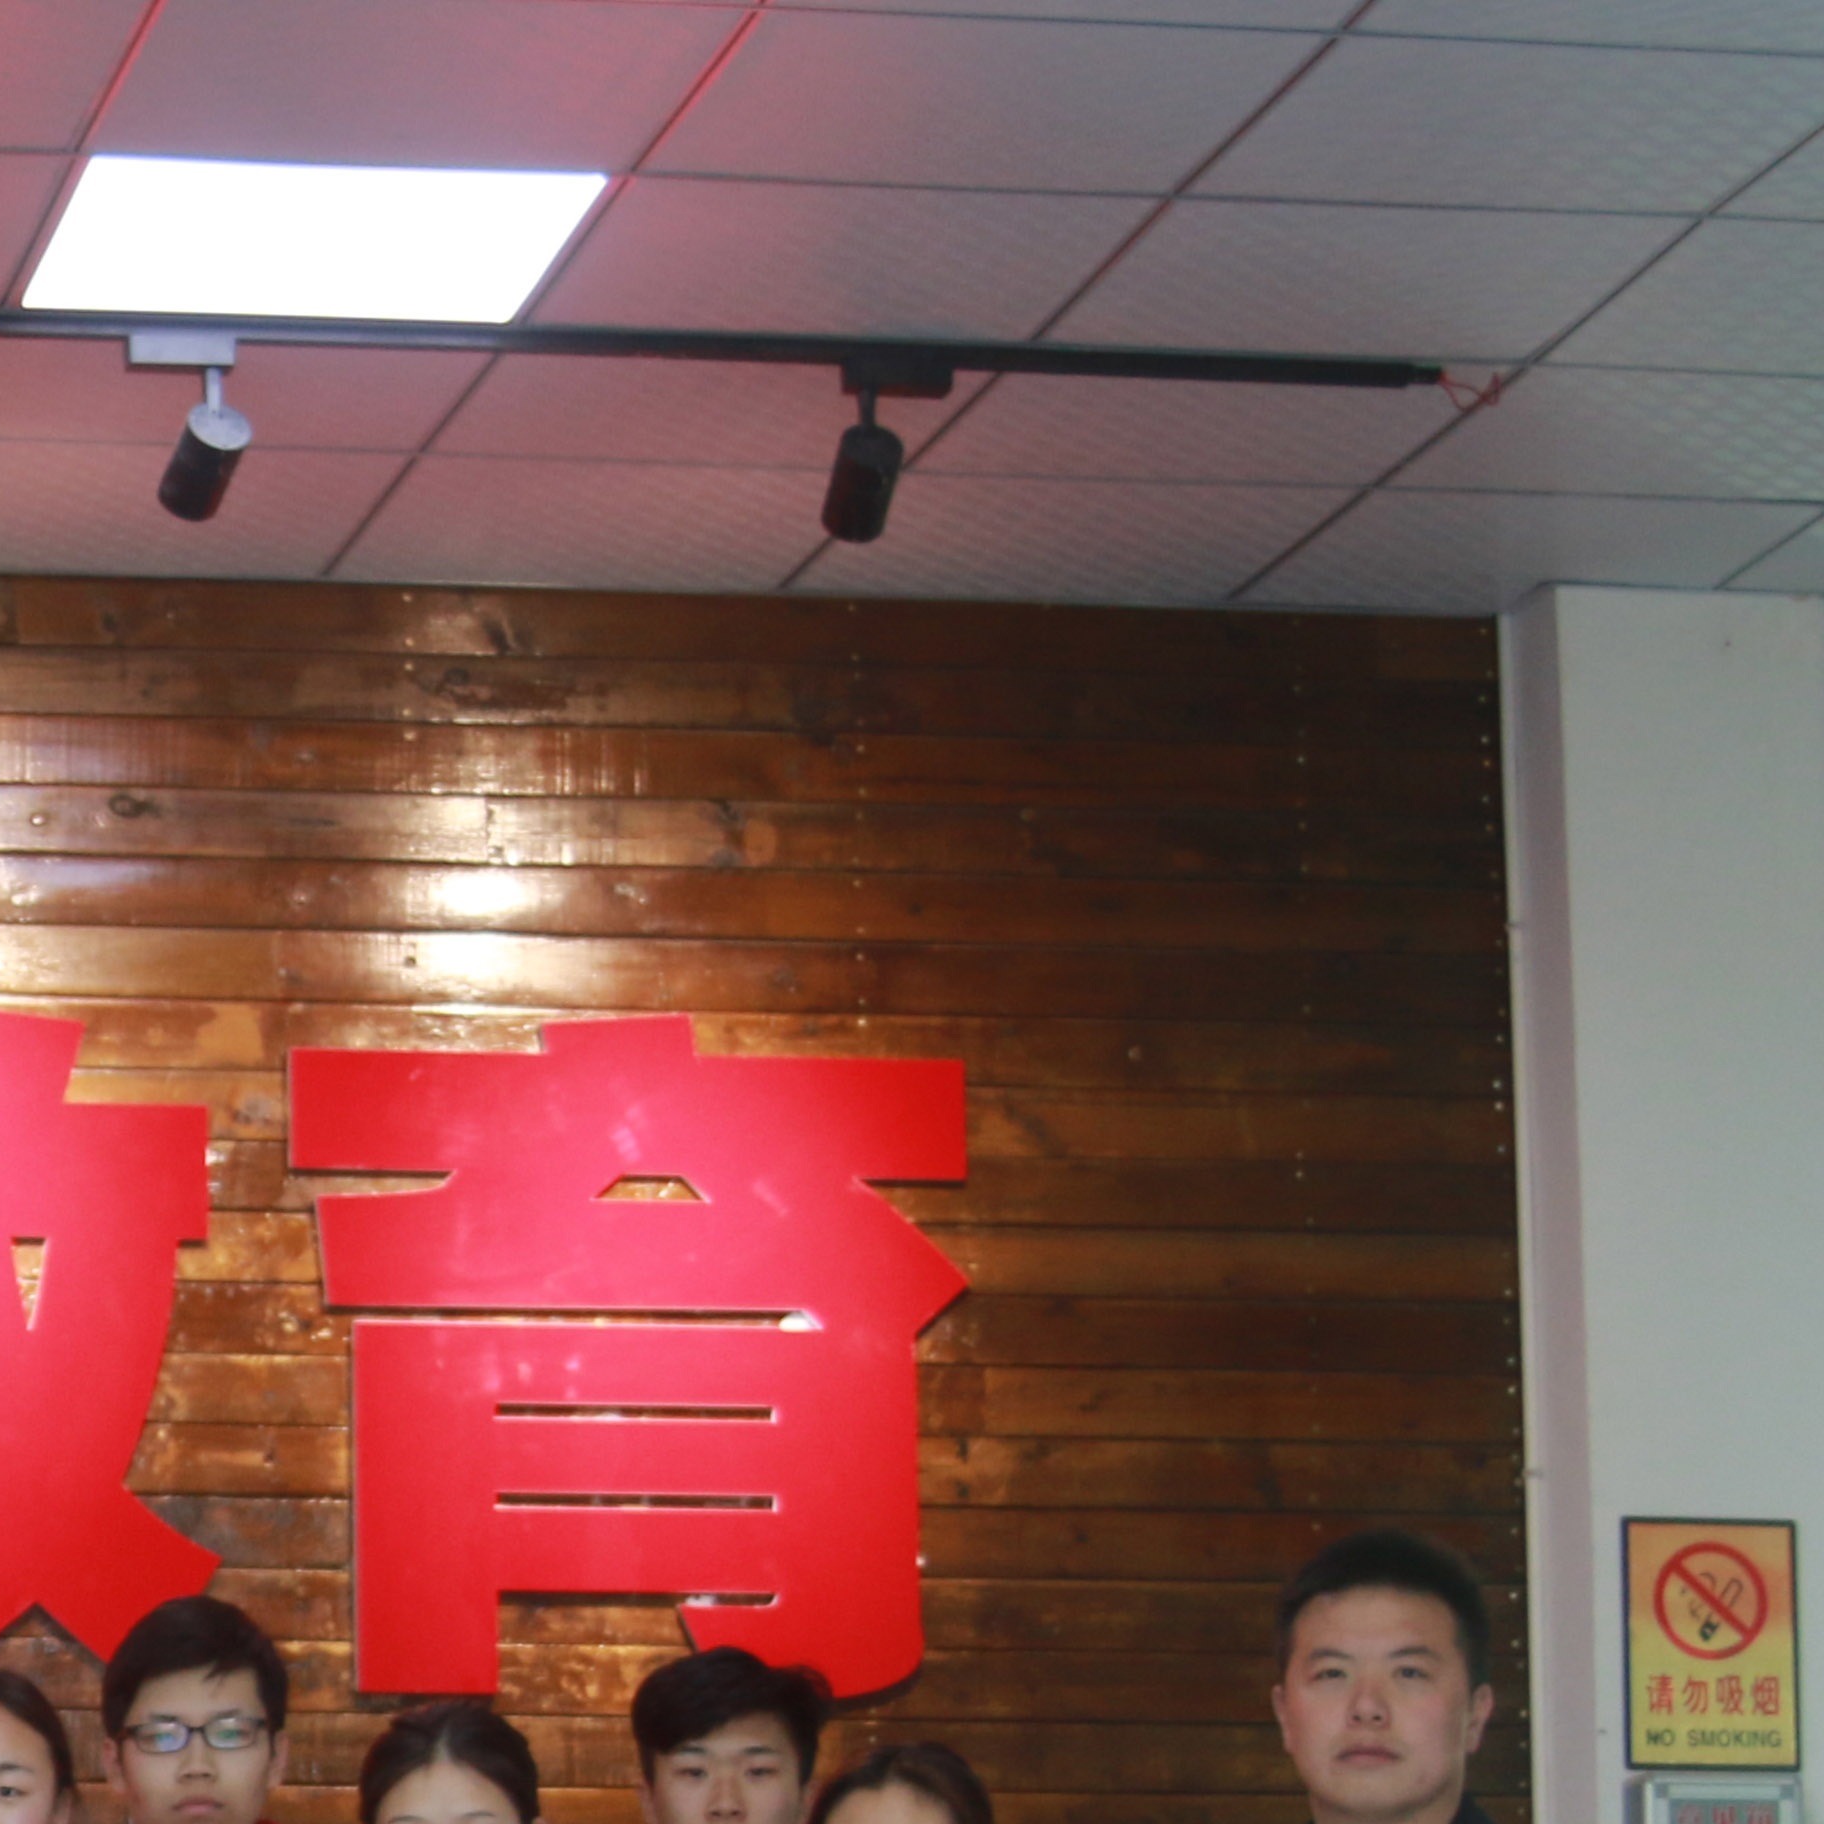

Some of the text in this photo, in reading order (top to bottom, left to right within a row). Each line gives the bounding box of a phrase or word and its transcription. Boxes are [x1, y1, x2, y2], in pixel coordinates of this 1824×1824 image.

[1646, 1674, 1781, 1716] 请勿吸烟
[1646, 1729, 1782, 1747] NO SMOKING
